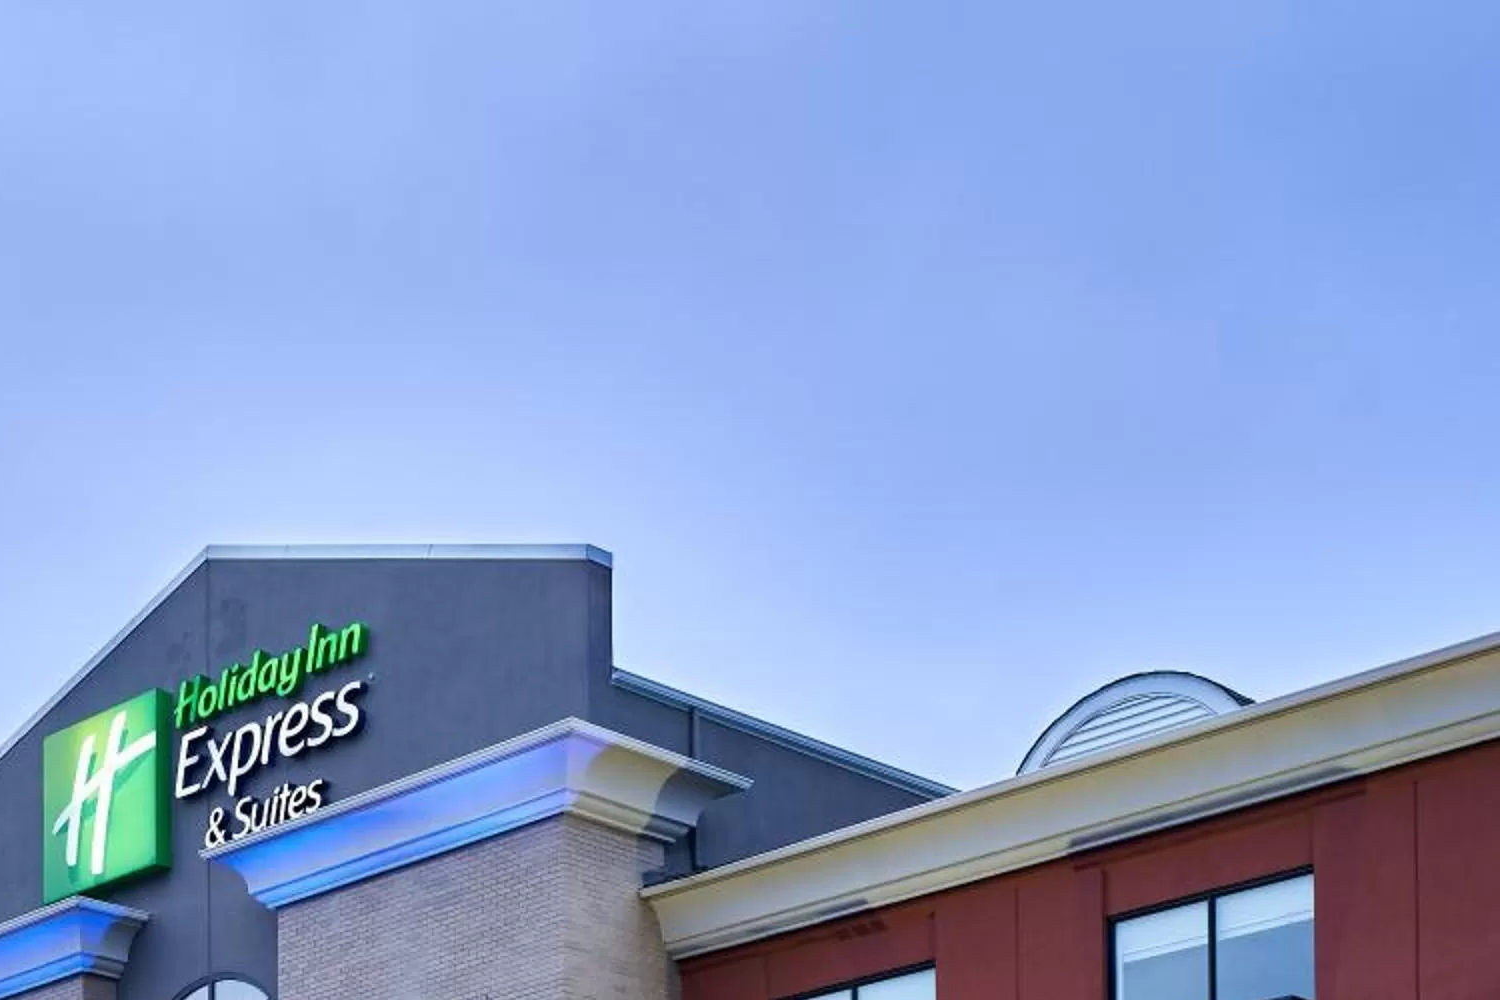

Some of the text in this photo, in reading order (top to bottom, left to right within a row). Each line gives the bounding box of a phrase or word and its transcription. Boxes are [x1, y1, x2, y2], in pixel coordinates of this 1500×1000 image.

[174, 622, 364, 729] Holiday Inn
[175, 680, 362, 798] Express
[205, 779, 324, 848] & Suites
